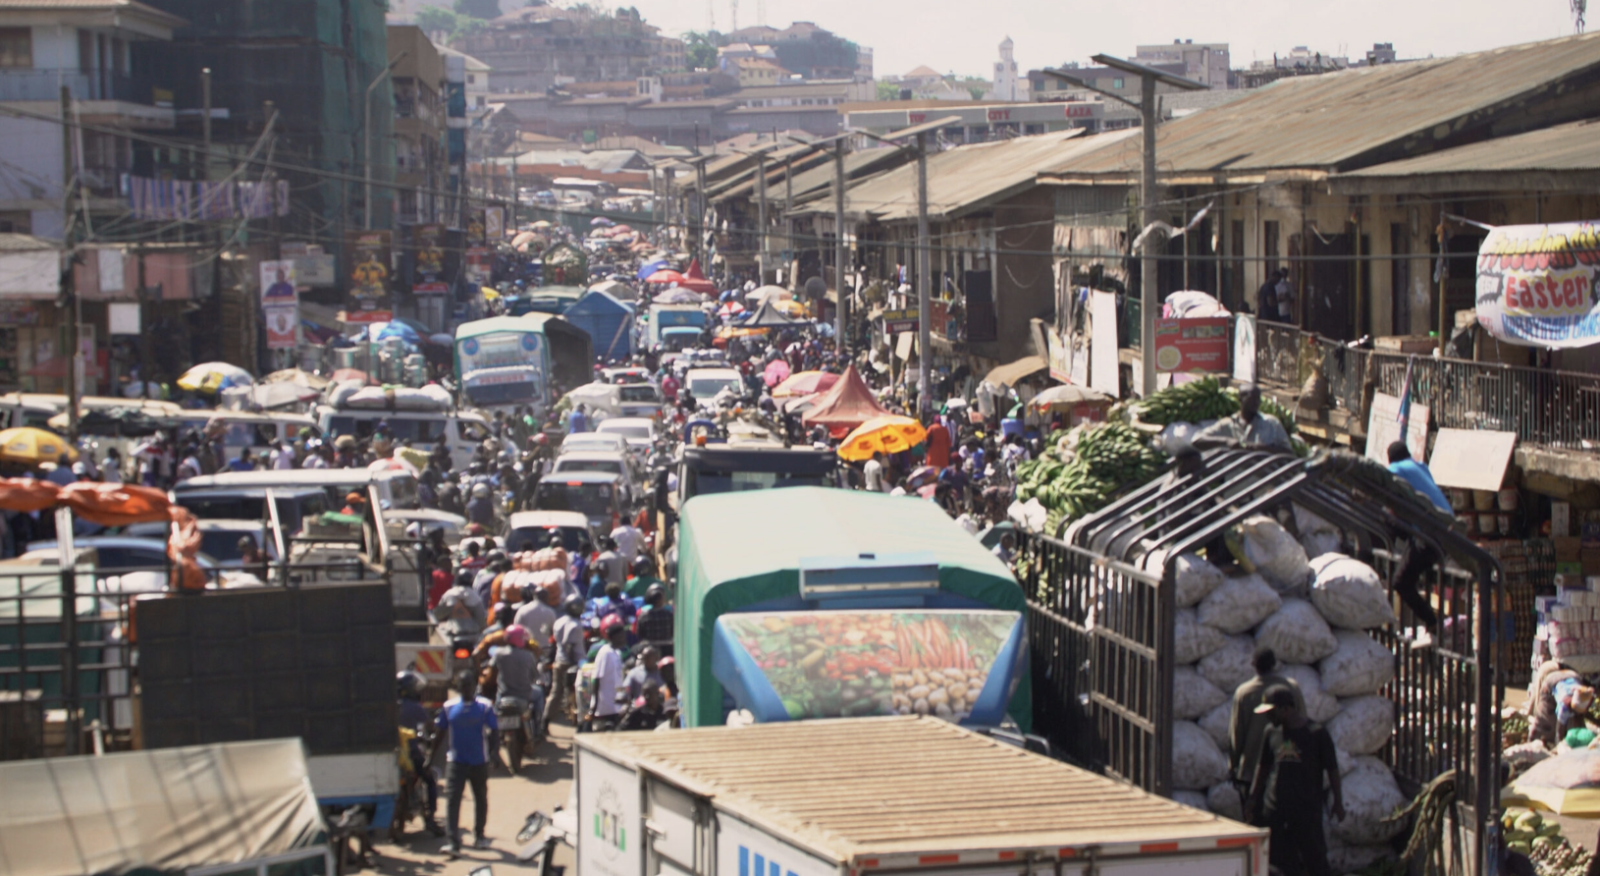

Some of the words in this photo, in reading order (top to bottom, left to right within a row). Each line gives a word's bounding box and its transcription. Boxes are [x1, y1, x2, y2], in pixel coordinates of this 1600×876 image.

[909, 113, 926, 123] TOP
[988, 109, 1011, 120] CITY
[1505, 275, 1588, 309] Easter
